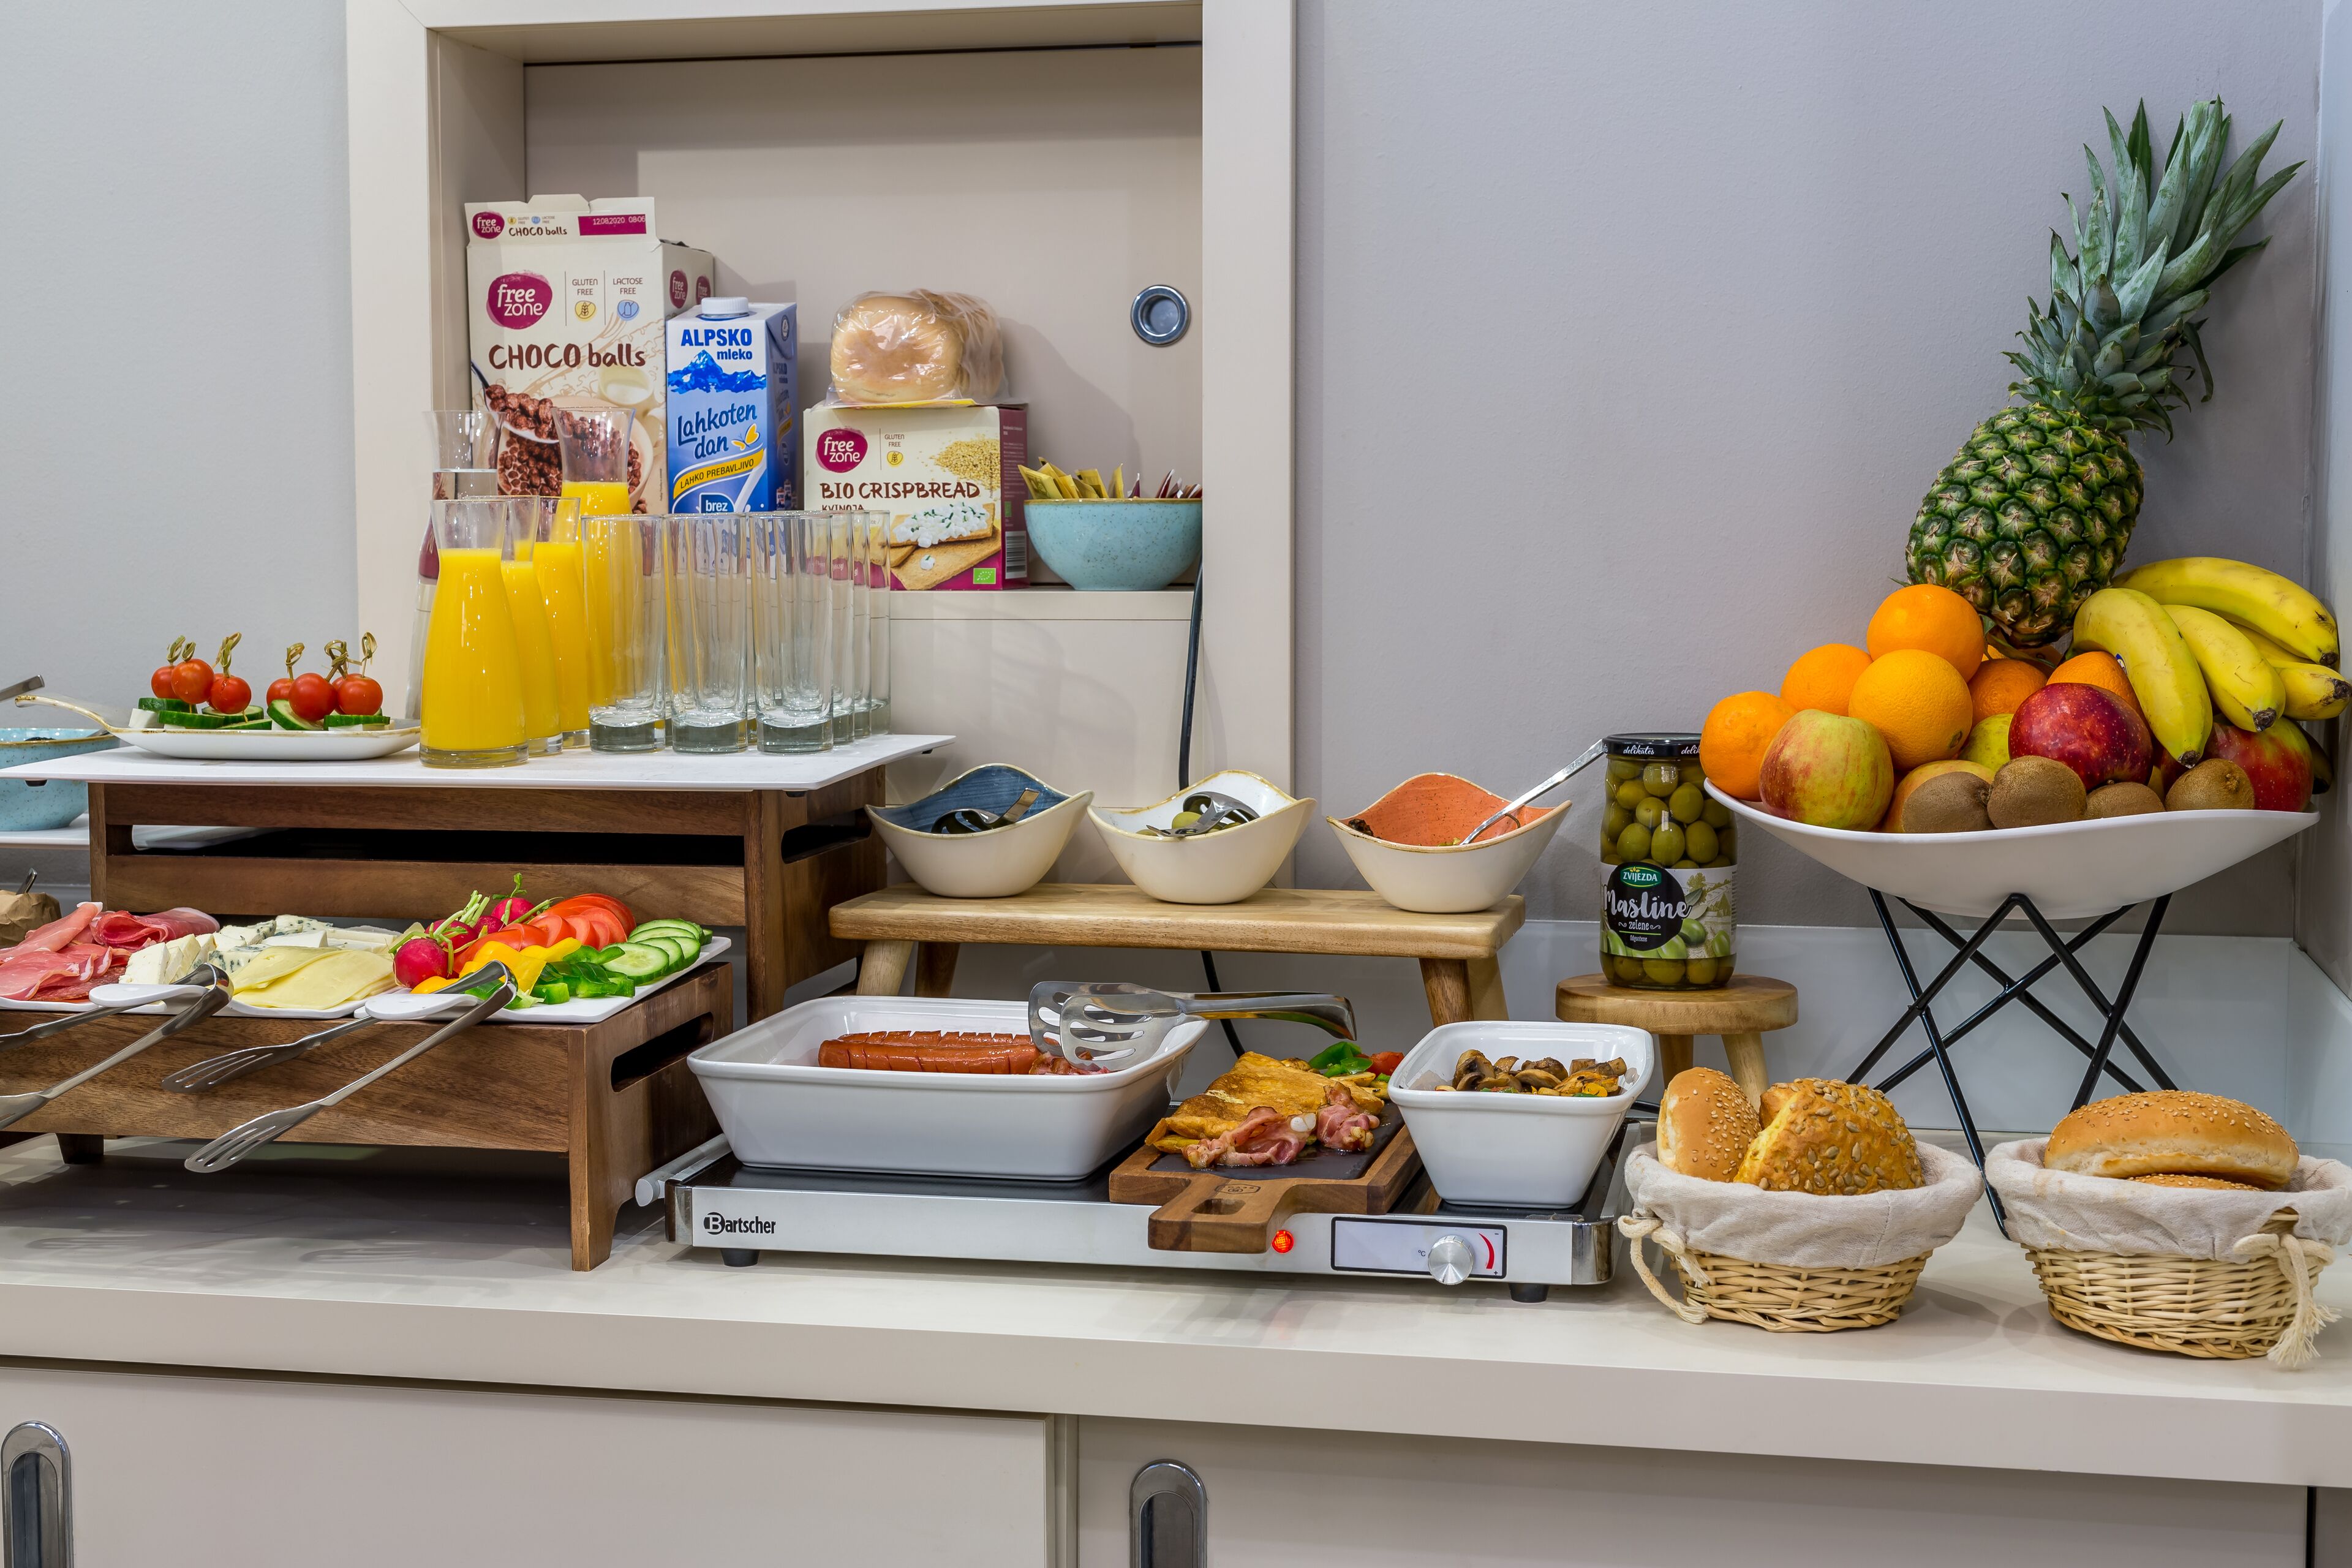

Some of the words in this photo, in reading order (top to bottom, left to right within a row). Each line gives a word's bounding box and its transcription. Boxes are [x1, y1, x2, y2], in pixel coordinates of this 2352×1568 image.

[477, 217, 496, 230] free
[509, 227, 543, 236] CHOCO
[546, 227, 567, 235] balls
[673, 277, 684, 292] free
[497, 284, 536, 307] free
[674, 290, 685, 301] zone
[504, 302, 543, 316] zone
[680, 328, 752, 347] ALPSKO
[489, 343, 581, 370] CHOCO
[588, 343, 647, 368] balls
[717, 349, 753, 360] mleko
[677, 403, 757, 447] Lahkoten
[695, 435, 729, 459] dan
[824, 437, 854, 455] free
[829, 451, 861, 462] zone
[680, 472, 704, 489] LAHKO
[706, 458, 754, 478] PREBAVLJIVO
[820, 483, 854, 499] BIO
[859, 481, 981, 499] CRISPBREAD
[706, 500, 728, 511] brez
[1623, 871, 1658, 883] ZVIJEZDA
[1604, 886, 1692, 919] Masline
[1629, 919, 1649, 930] zelene
[703, 1212, 776, 1235] Bartscher
